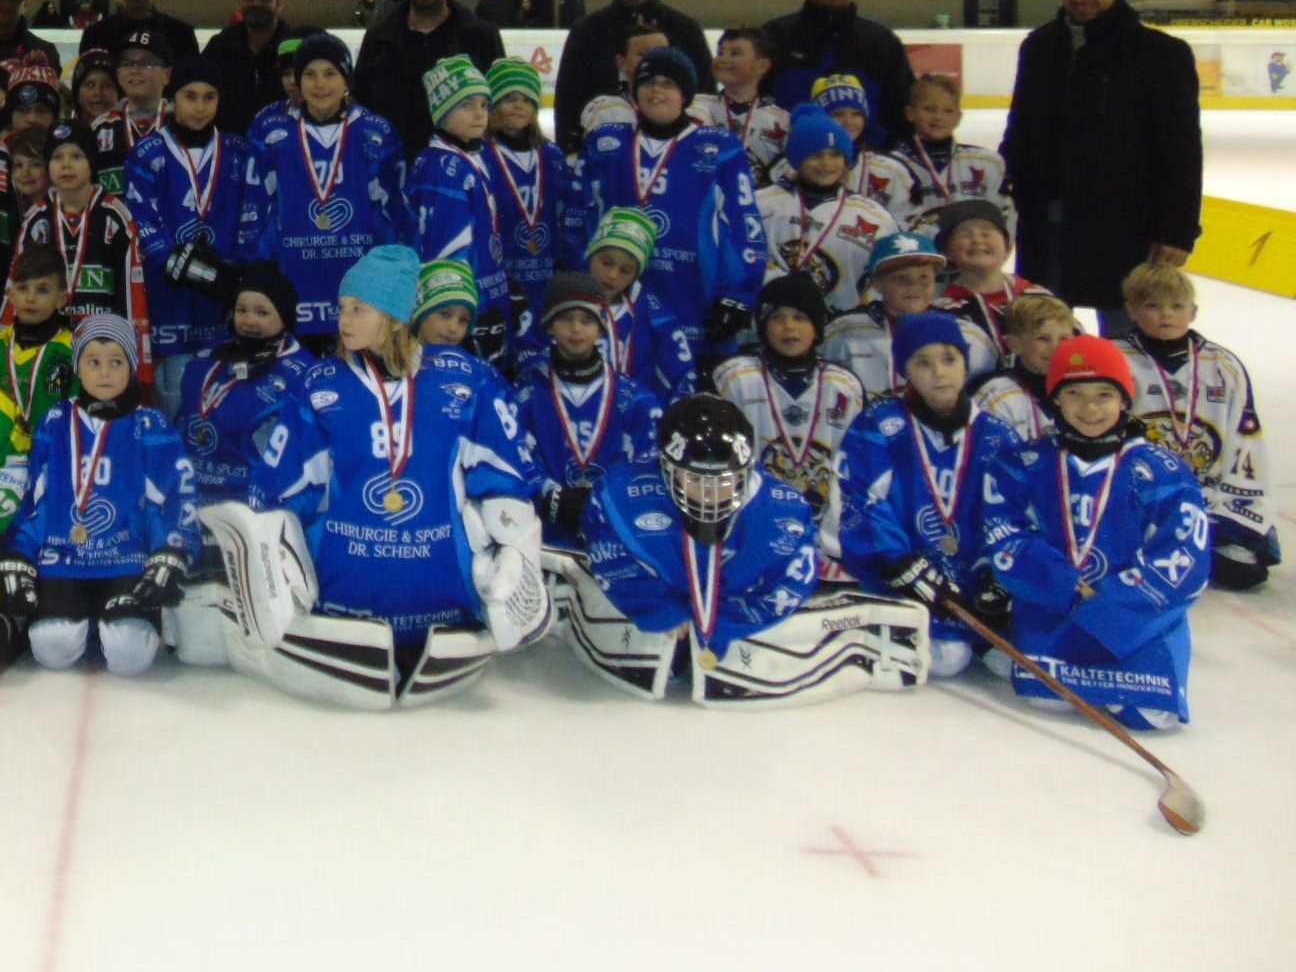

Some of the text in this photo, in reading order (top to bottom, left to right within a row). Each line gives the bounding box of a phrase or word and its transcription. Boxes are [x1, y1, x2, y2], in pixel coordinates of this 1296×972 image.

[351, 233, 375, 246] SPOR
[326, 520, 451, 544] CHIRURGIE & SPORT
[1175, 501, 1209, 550] 30
[348, 541, 431, 559] DR. SCHENK
[821, 615, 862, 631] Reebok
